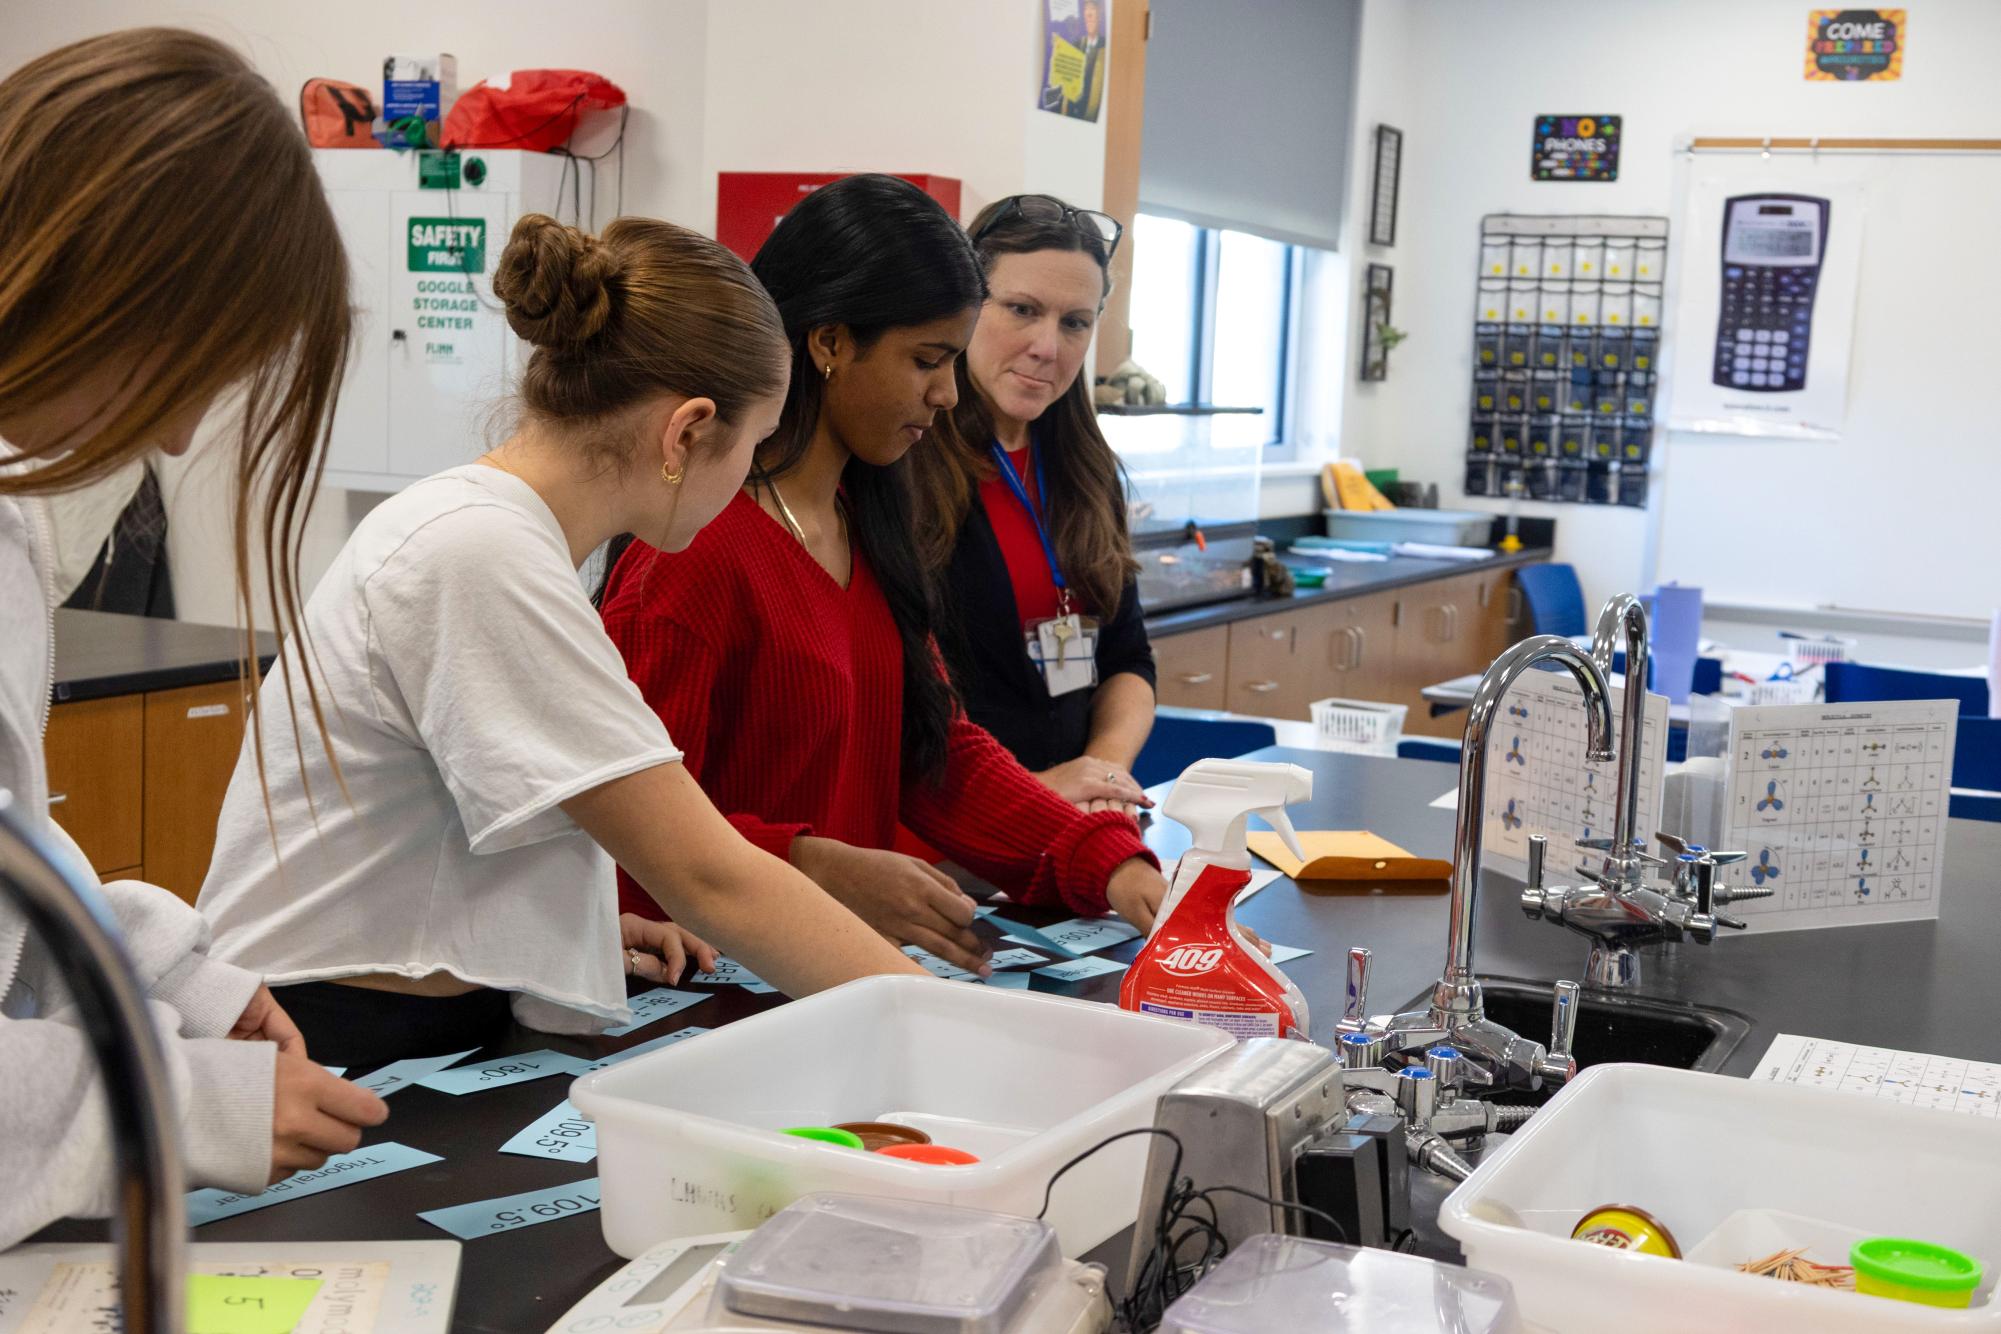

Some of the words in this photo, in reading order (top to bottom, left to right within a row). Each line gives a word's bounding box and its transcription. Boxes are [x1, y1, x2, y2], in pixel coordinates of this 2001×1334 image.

[1826, 21, 1885, 40] COME
[1543, 137, 1607, 153] PHONES
[411, 224, 482, 247] SAFETY
[416, 280, 475, 294] GOGGLE
[413, 297, 478, 312] STORAGE
[416, 315, 473, 329] CENTER
[1156, 948, 1224, 972] 409
[479, 1061, 541, 1081] 180°
[294, 1156, 386, 1185] Trigonal
[214, 1180, 294, 1207] Plar
[490, 1194, 600, 1230] 109.5°
[223, 1296, 264, 1310] 5
